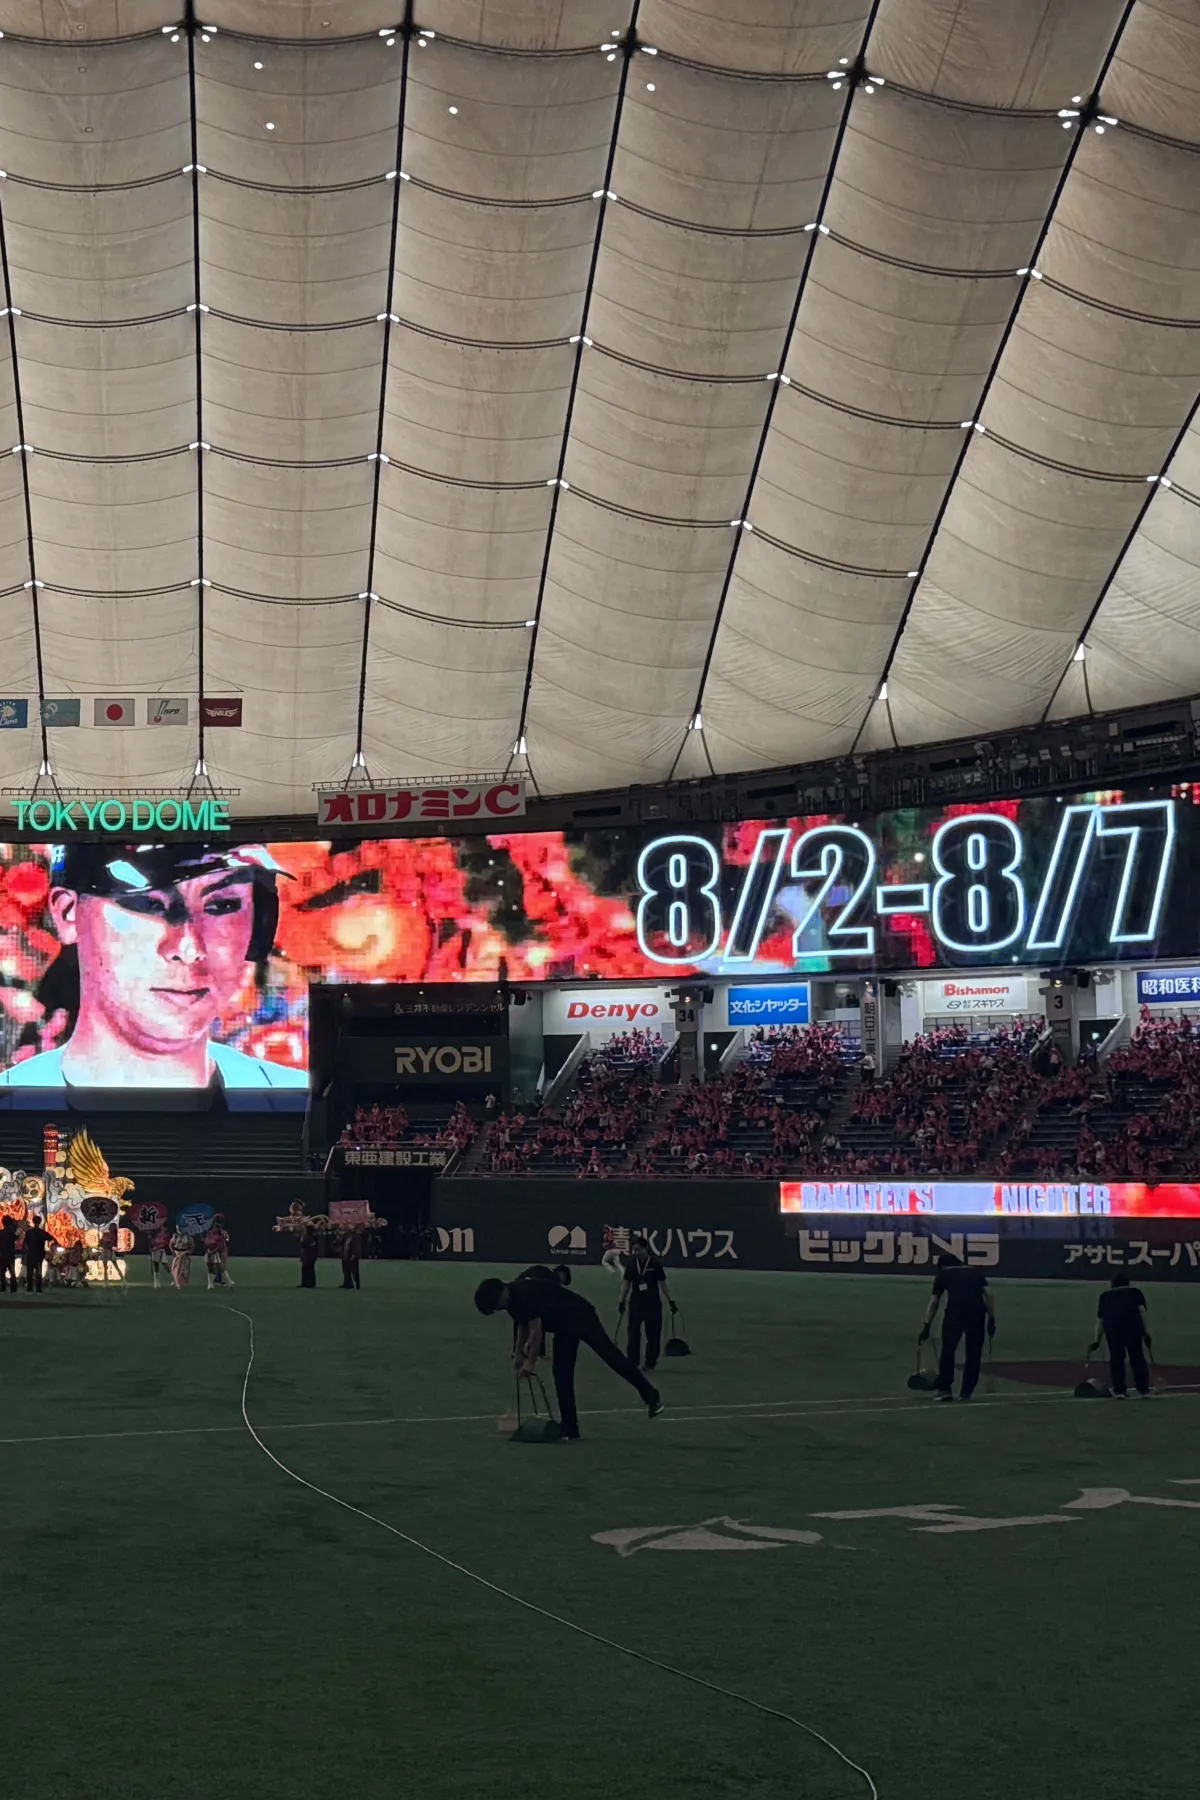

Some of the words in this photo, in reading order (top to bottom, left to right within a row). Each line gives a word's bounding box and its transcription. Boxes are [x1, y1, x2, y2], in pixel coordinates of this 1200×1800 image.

[10, 799, 126, 831] TOKYO
[132, 799, 231, 831] DOME
[323, 783, 521, 823] オロナミンC
[636, 799, 1175, 965] 8/2-8/7
[944, 984, 1010, 997] Bishamon
[1054, 995, 1063, 1009] 3
[567, 1002, 659, 1022] Denyo
[678, 1009, 695, 1022] 34
[394, 1045, 491, 1074] RYOBI
[345, 1150, 447, 1167] 東亜建設工業
[1001, 1184, 1113, 1215] NIGHTER
[799, 1230, 1000, 1266] ビックカメラ
